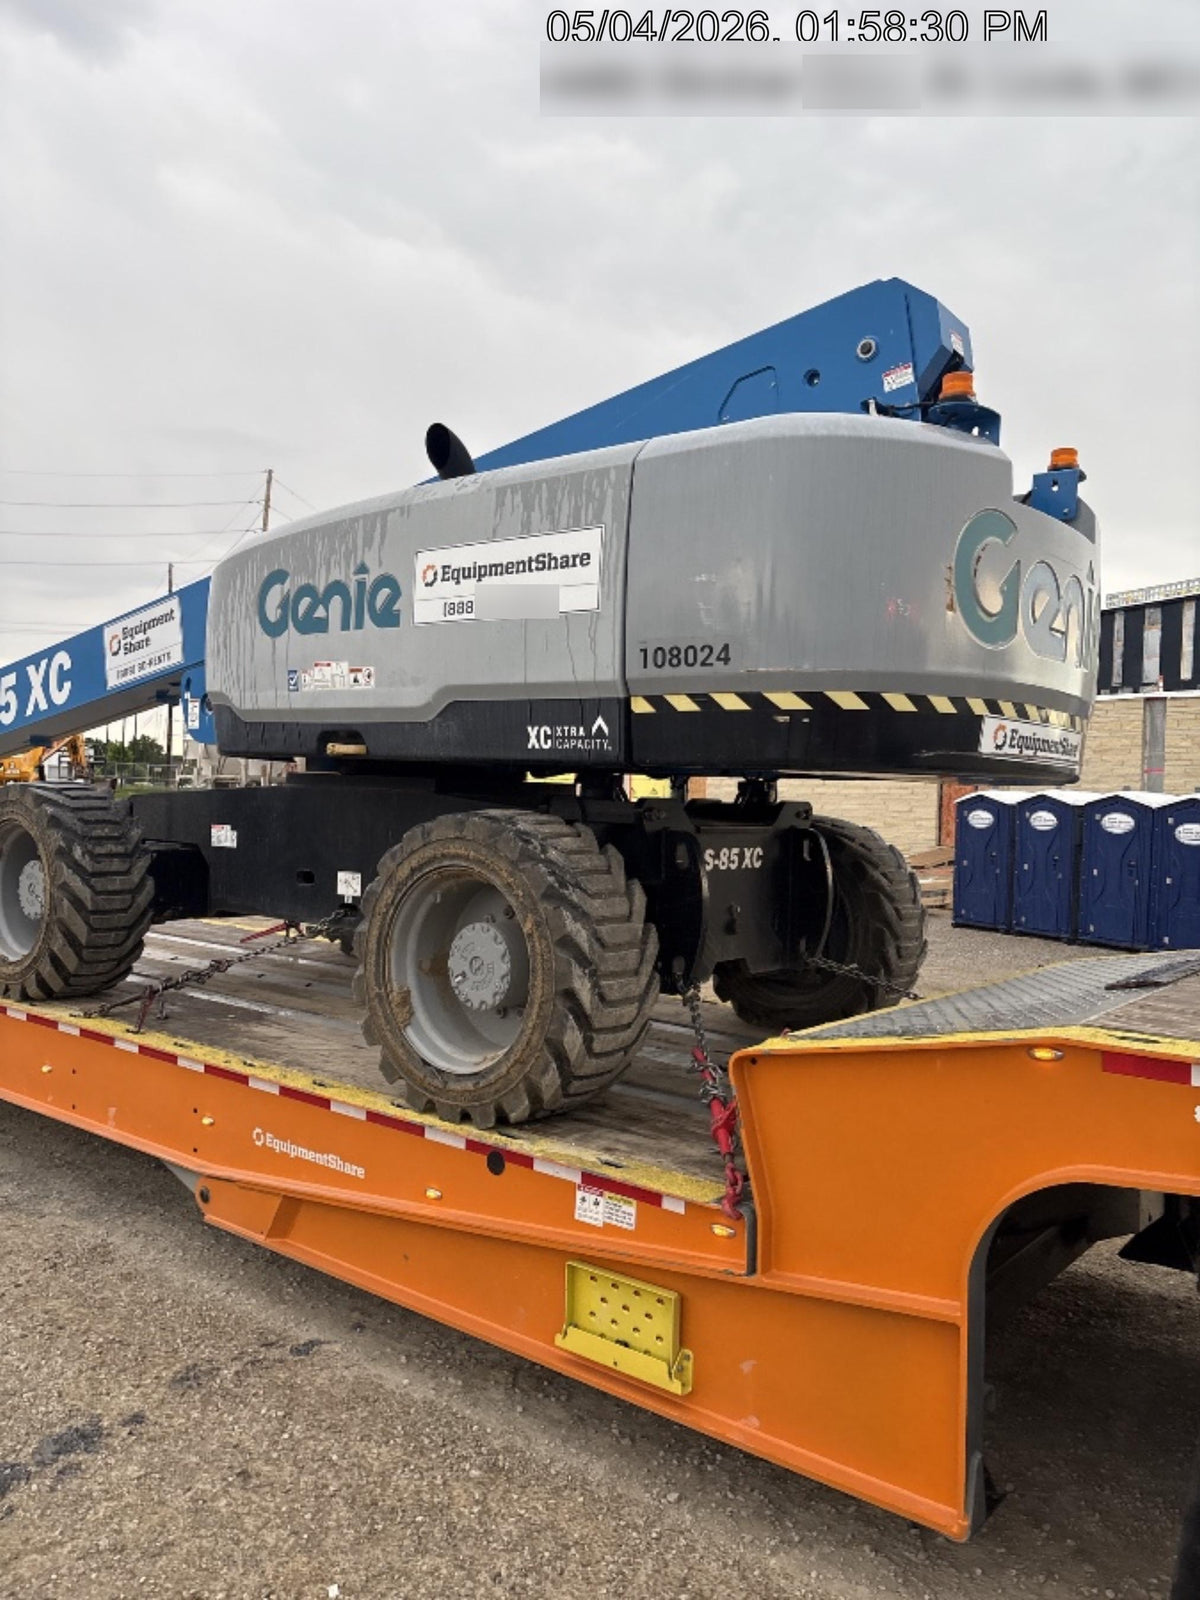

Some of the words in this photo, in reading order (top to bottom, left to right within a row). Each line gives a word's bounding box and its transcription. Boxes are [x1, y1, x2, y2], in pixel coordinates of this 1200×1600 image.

[440, 552, 591, 586] EquipmentShare
[258, 560, 402, 639] Genie
[121, 608, 176, 641] Equipment
[123, 636, 152, 656] Share
[639, 643, 731, 669] 108024
[25, 650, 72, 718] XC
[526, 725, 553, 750] XC
[556, 726, 586, 737] XTRA
[704, 847, 740, 871] S-85
[741, 846, 764, 869] XC
[265, 1132, 366, 1180] EquipmentShare
